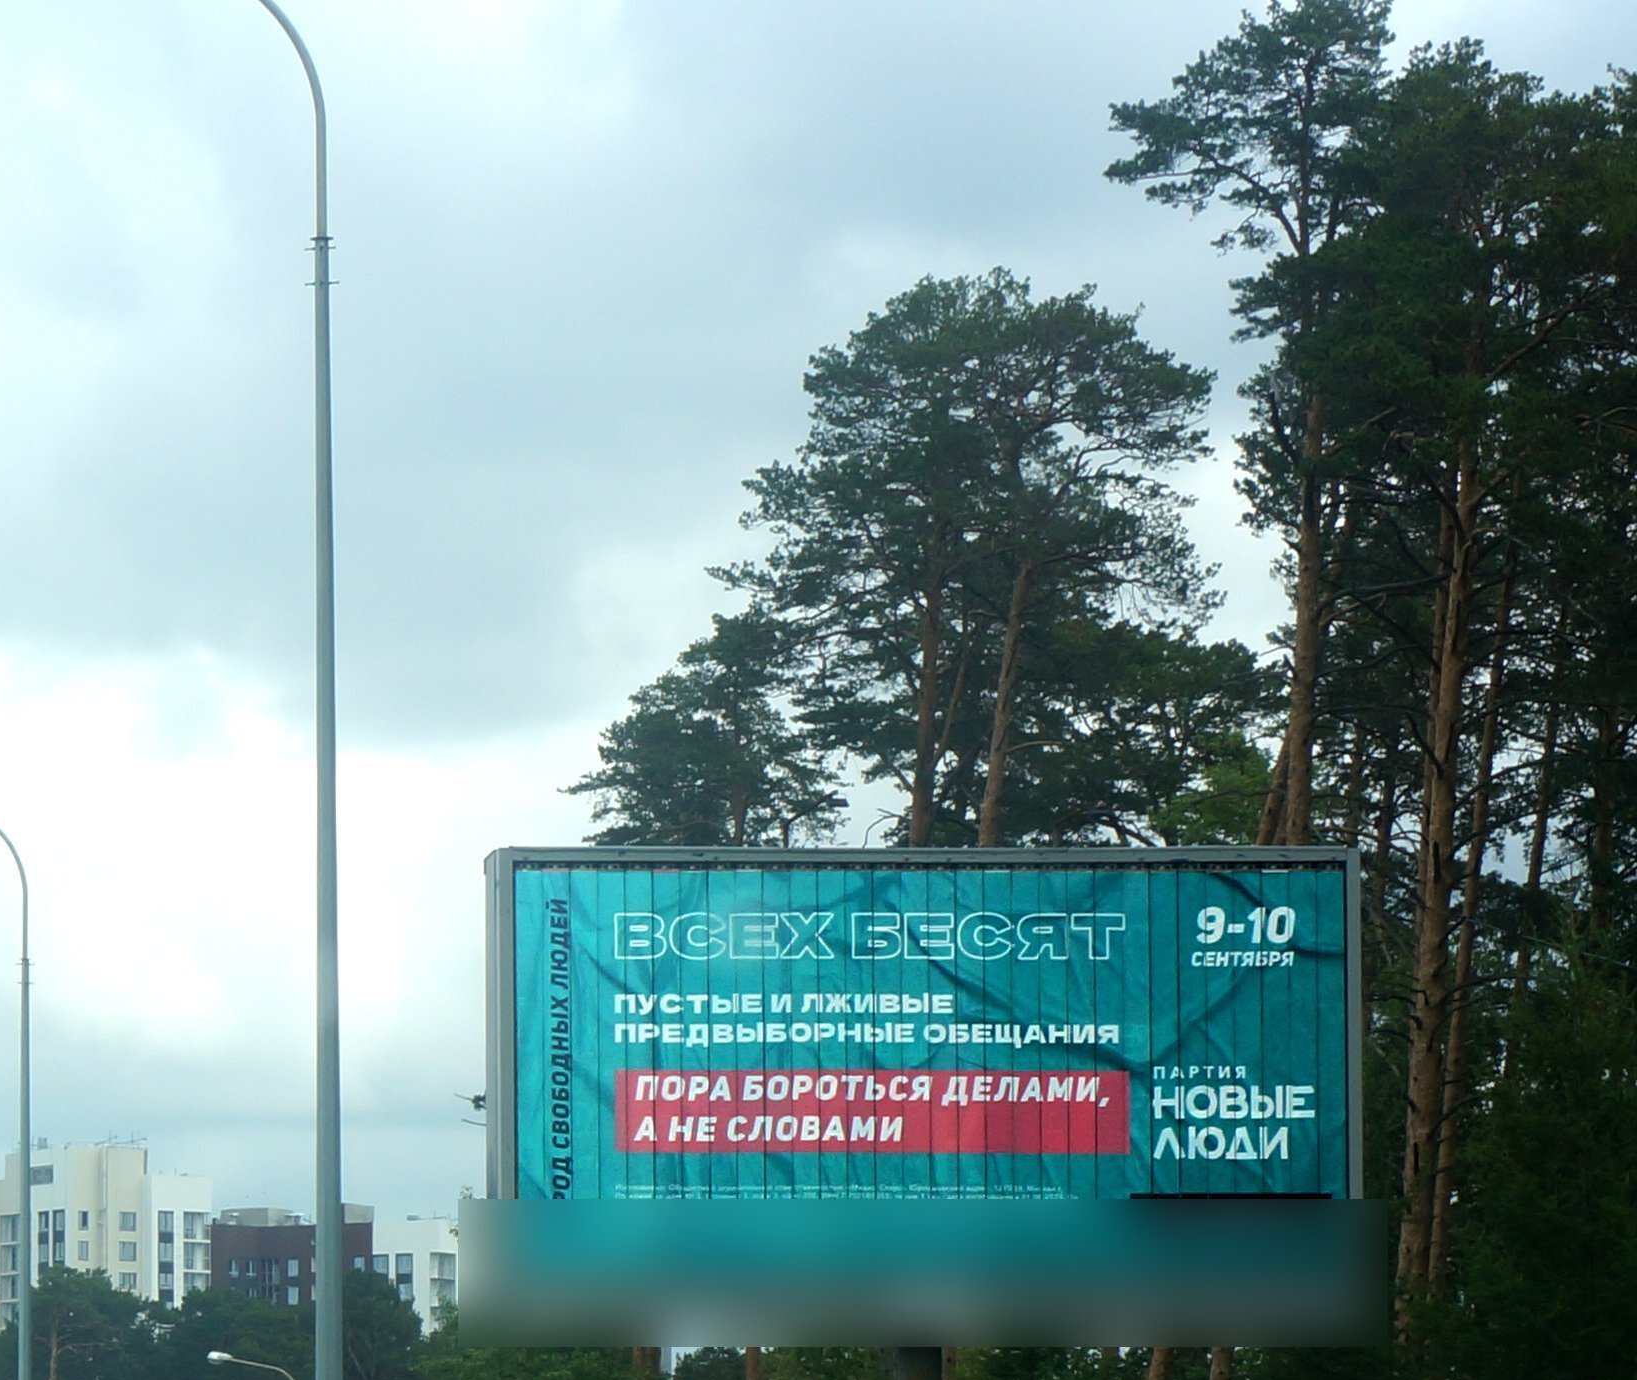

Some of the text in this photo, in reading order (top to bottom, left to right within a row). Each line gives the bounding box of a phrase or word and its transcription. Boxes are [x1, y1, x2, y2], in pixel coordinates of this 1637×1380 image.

[614, 911, 1126, 961] ВСЕХ БЕСЯТ
[1196, 906, 1296, 944] 9-10
[546, 898, 572, 989] ЛЮДЕЙ
[1191, 951, 1294, 967] СЕНТЯБРЯ
[613, 993, 954, 1016] ПУСТЫЕ И ЛЖИВЫЕ
[613, 1022, 1120, 1049] ПРЕДВЫБОРНЫЕ ОБЕЩАНИЯ
[551, 996, 573, 1149] СВОБОДНЫХ
[1153, 1065, 1247, 1079] ПАРТИЯ
[635, 1075, 1110, 1107] ПОРА БОРОТЬСЯ ДЕЛАМИ,
[1152, 1084, 1315, 1119] НОВЫЕ
[633, 1115, 903, 1142] А НЕ СЛОВАМИ
[1153, 1126, 1289, 1160] ЛЮДИ
